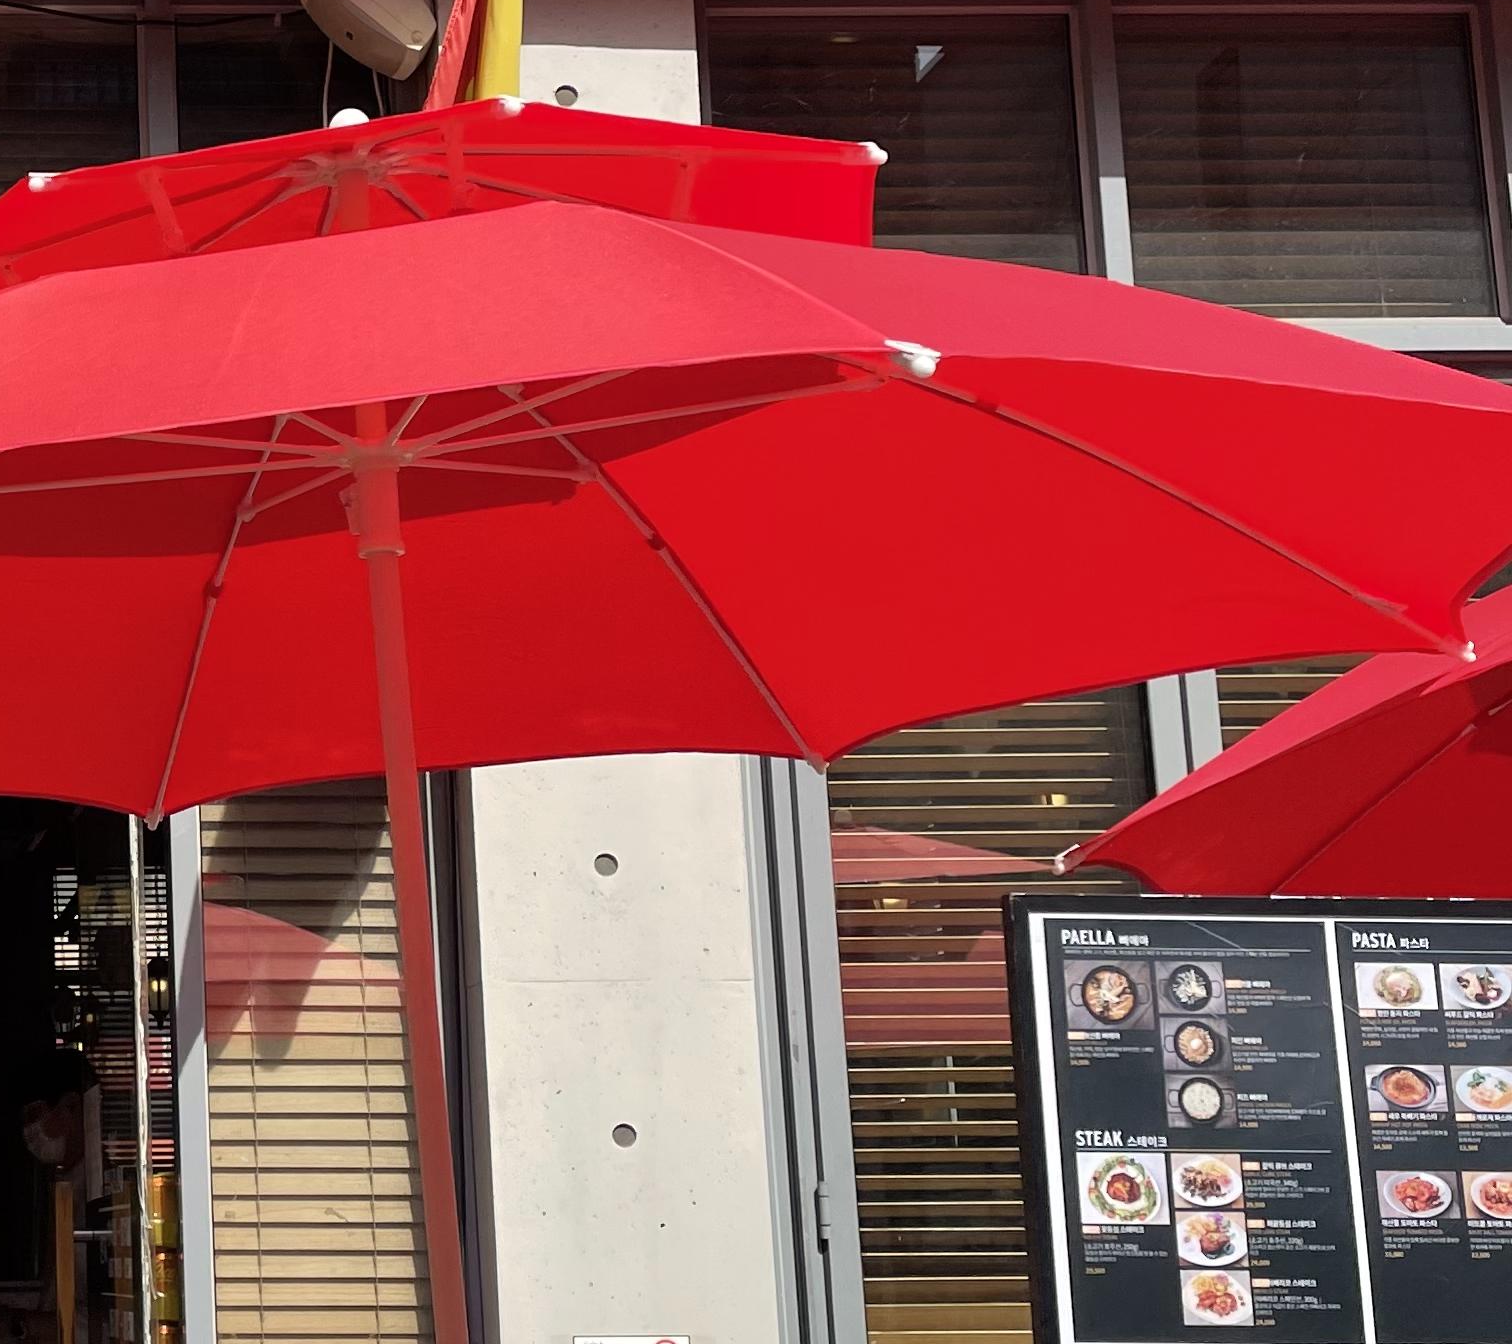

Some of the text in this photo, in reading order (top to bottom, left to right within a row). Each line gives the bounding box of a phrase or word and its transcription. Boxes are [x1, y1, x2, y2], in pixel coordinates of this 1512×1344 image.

[1061, 928, 1116, 947] PAELLA
[1352, 931, 1430, 950] PASTA 파스타
[1075, 1130, 1168, 1148] STEAK 스테이크
